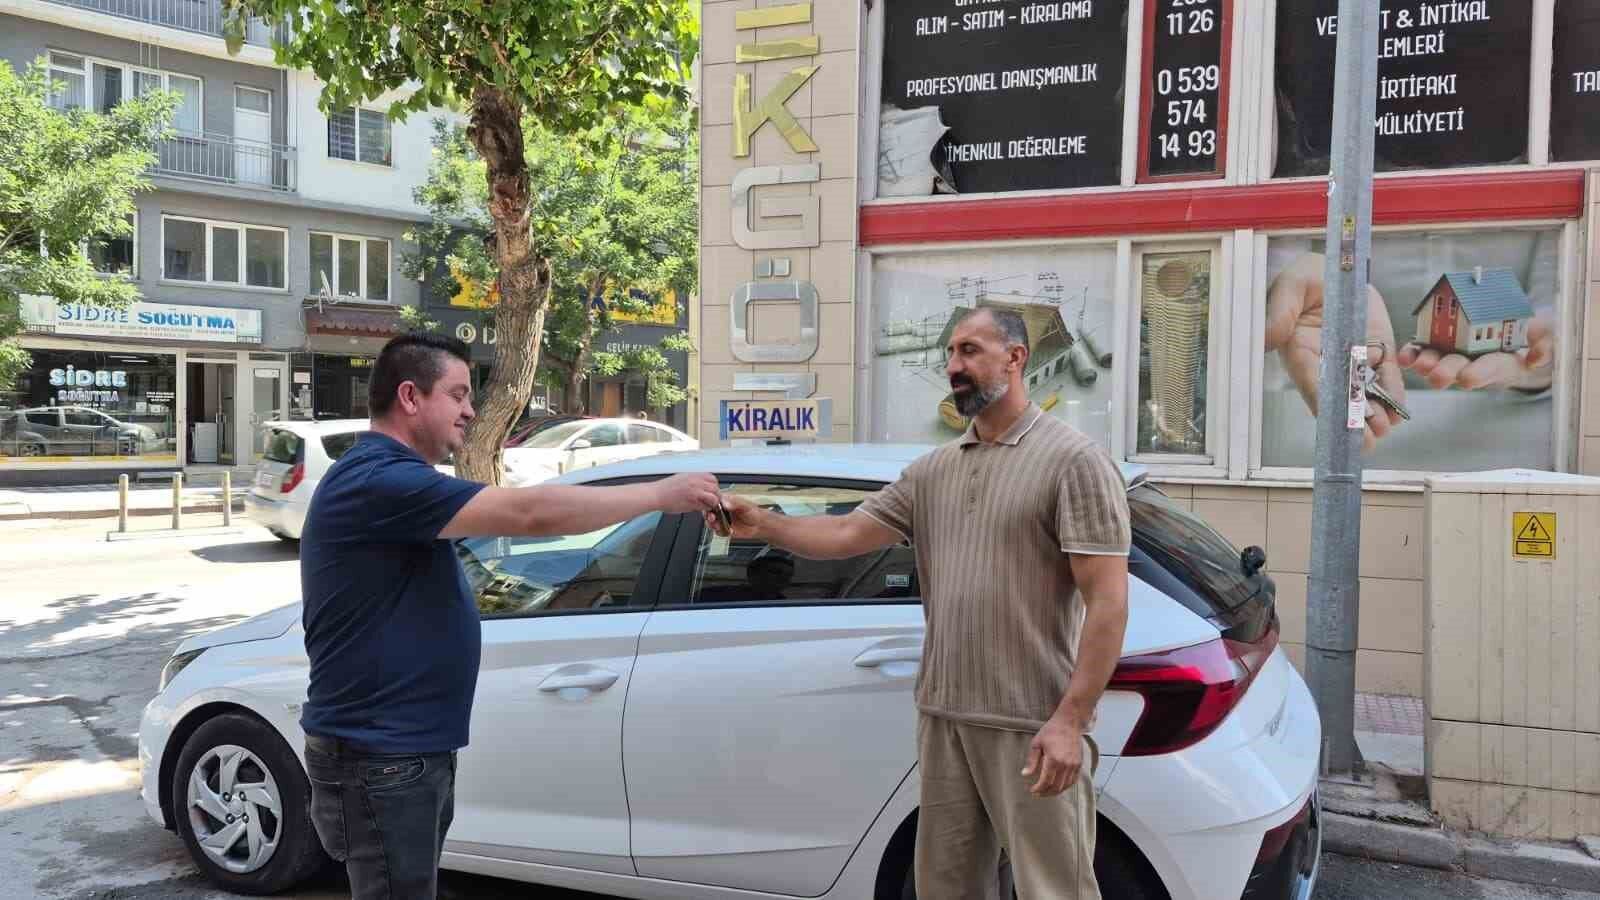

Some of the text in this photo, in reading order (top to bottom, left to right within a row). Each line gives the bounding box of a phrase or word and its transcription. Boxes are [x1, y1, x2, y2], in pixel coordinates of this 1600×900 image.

[915, 16, 948, 36] ALIM
[962, 9, 1005, 31] SATIM
[1020, 0, 1092, 25] KİRALAMA
[1166, 9, 1214, 36] 11 26
[1396, 9, 1414, 29] &
[1419, 0, 1491, 27] İNTİKAL
[1377, 29, 1446, 58] EMLERİ
[906, 63, 1097, 98] PROFESYONEL DANIŞMANLIK
[1158, 64, 1219, 96] 0 539
[1380, 73, 1457, 100] İRTİFAKI
[1167, 98, 1207, 127] 574
[945, 135, 1087, 163] İMENKUL DEĞERLEME
[1158, 129, 1216, 159] 14 93
[49, 363, 128, 388] SİDRE
[728, 402, 815, 433] KİRALIK
